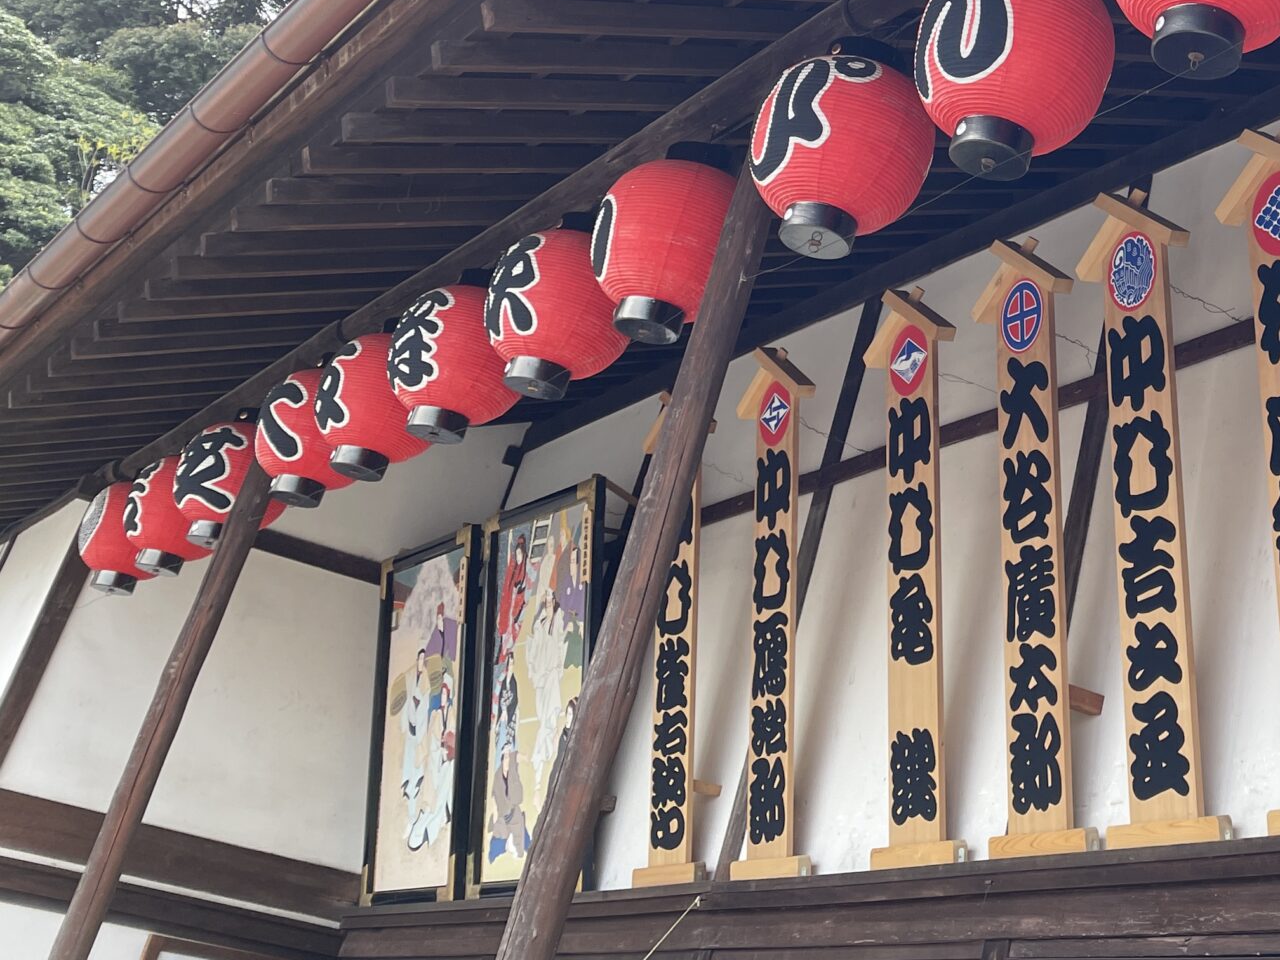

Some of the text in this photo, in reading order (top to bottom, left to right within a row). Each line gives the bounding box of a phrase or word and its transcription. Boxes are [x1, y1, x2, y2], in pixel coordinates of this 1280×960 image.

[650, 495, 694, 851] 村雀右衛門
